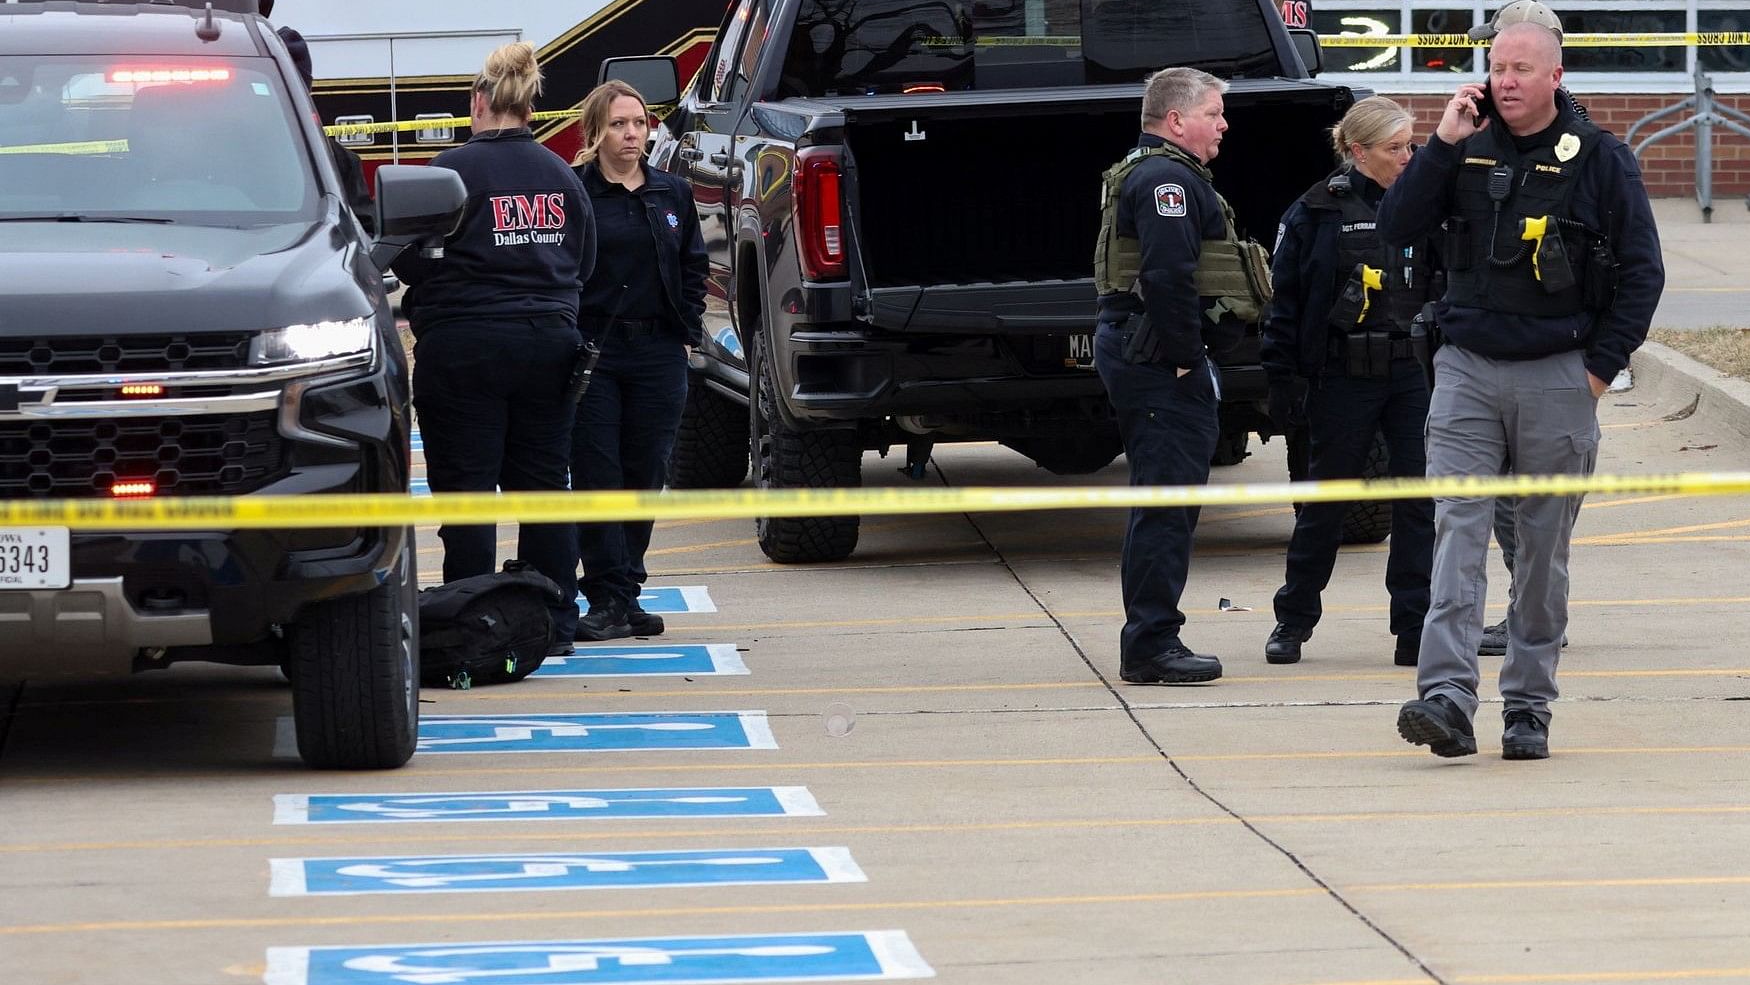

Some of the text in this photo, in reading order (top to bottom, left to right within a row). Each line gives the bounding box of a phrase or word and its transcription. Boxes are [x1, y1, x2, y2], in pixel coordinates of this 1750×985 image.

[1281, 0, 1307, 28] MS
[1417, 34, 1446, 45] CROSS
[1697, 33, 1724, 44] CROSS
[1728, 33, 1743, 44] NOT
[1535, 164, 1561, 174] POLICE
[490, 193, 565, 232] EMS
[493, 230, 566, 246] Dallas County
[1069, 334, 1096, 358] MA
